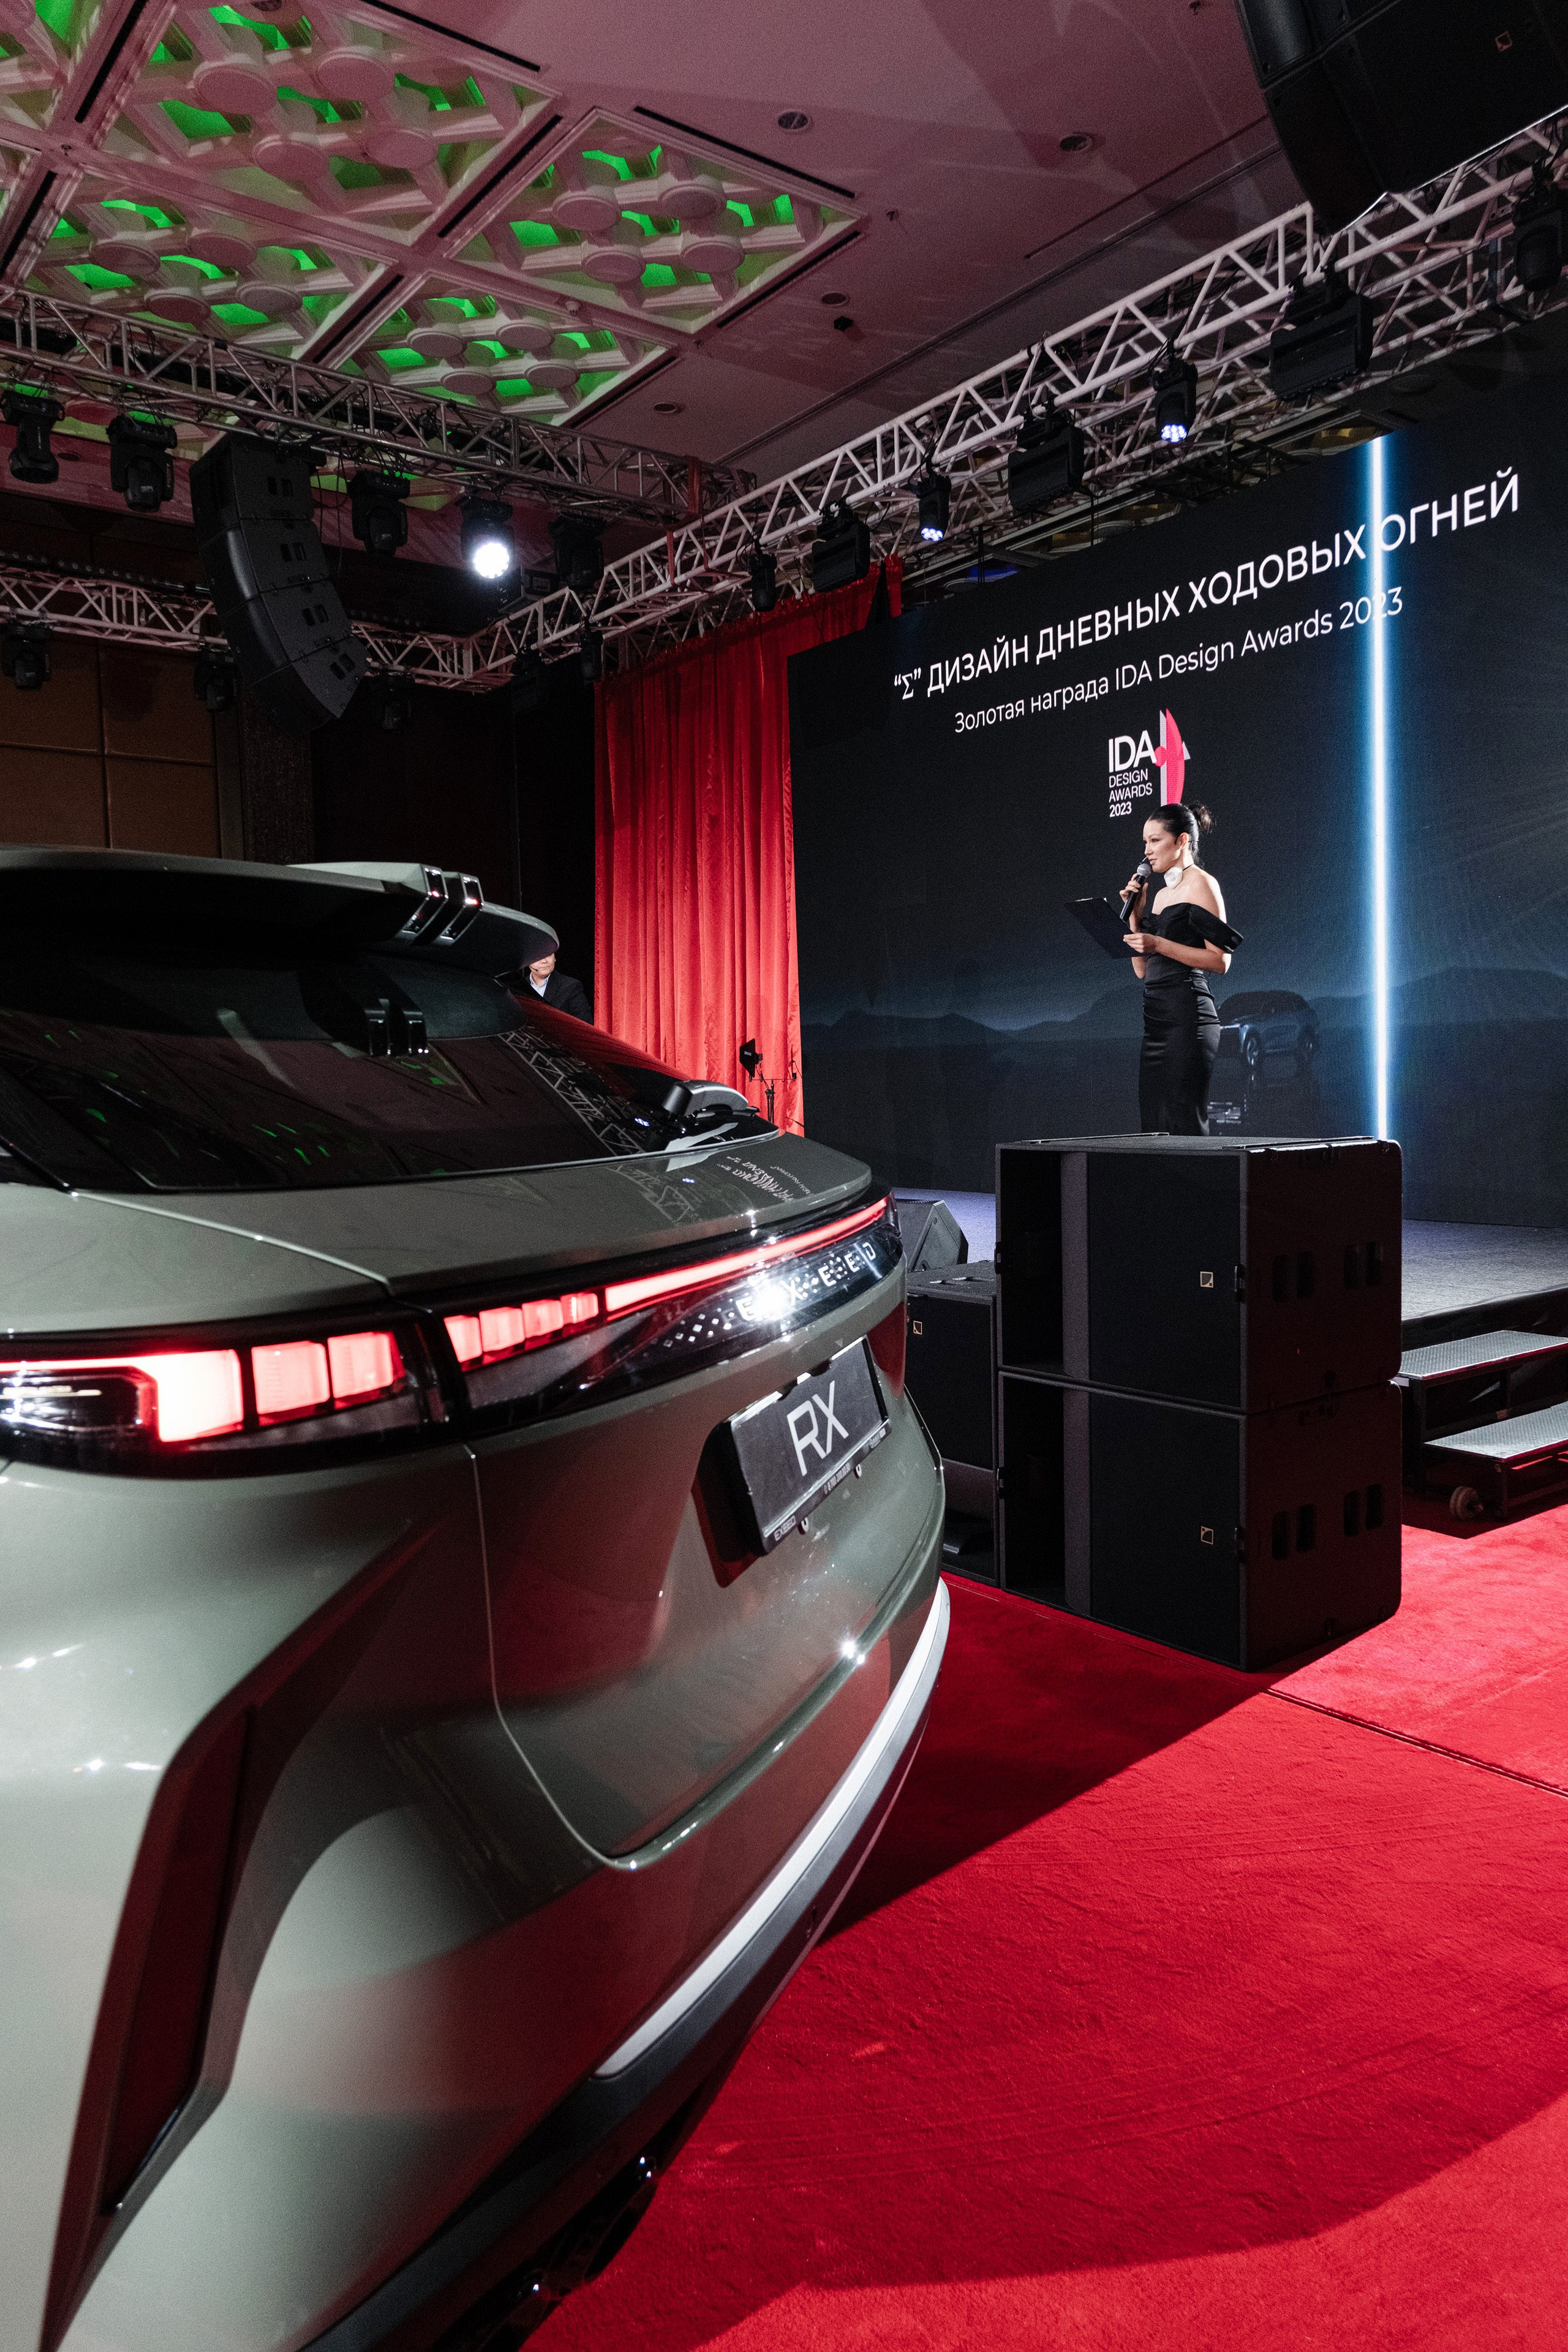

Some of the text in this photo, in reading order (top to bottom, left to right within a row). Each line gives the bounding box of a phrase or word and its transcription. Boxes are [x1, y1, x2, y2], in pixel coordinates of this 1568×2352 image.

[927, 634, 1028, 698] ДИЗАЙН
[1036, 586, 1180, 666] ДНЕВНЫХ
[1188, 524, 1366, 613] ХОДОВЫХ
[1378, 466, 1518, 552] ОГНЕЙ
[955, 586, 1403, 733] Золотая награда IDA Design Awards 2023
[1108, 729, 1157, 773] IDA
[1109, 768, 1148, 788] DESIGN
[1109, 782, 1153, 803] AWARDS
[1109, 801, 1132, 818] 2023
[786, 1380, 849, 1477] RX
